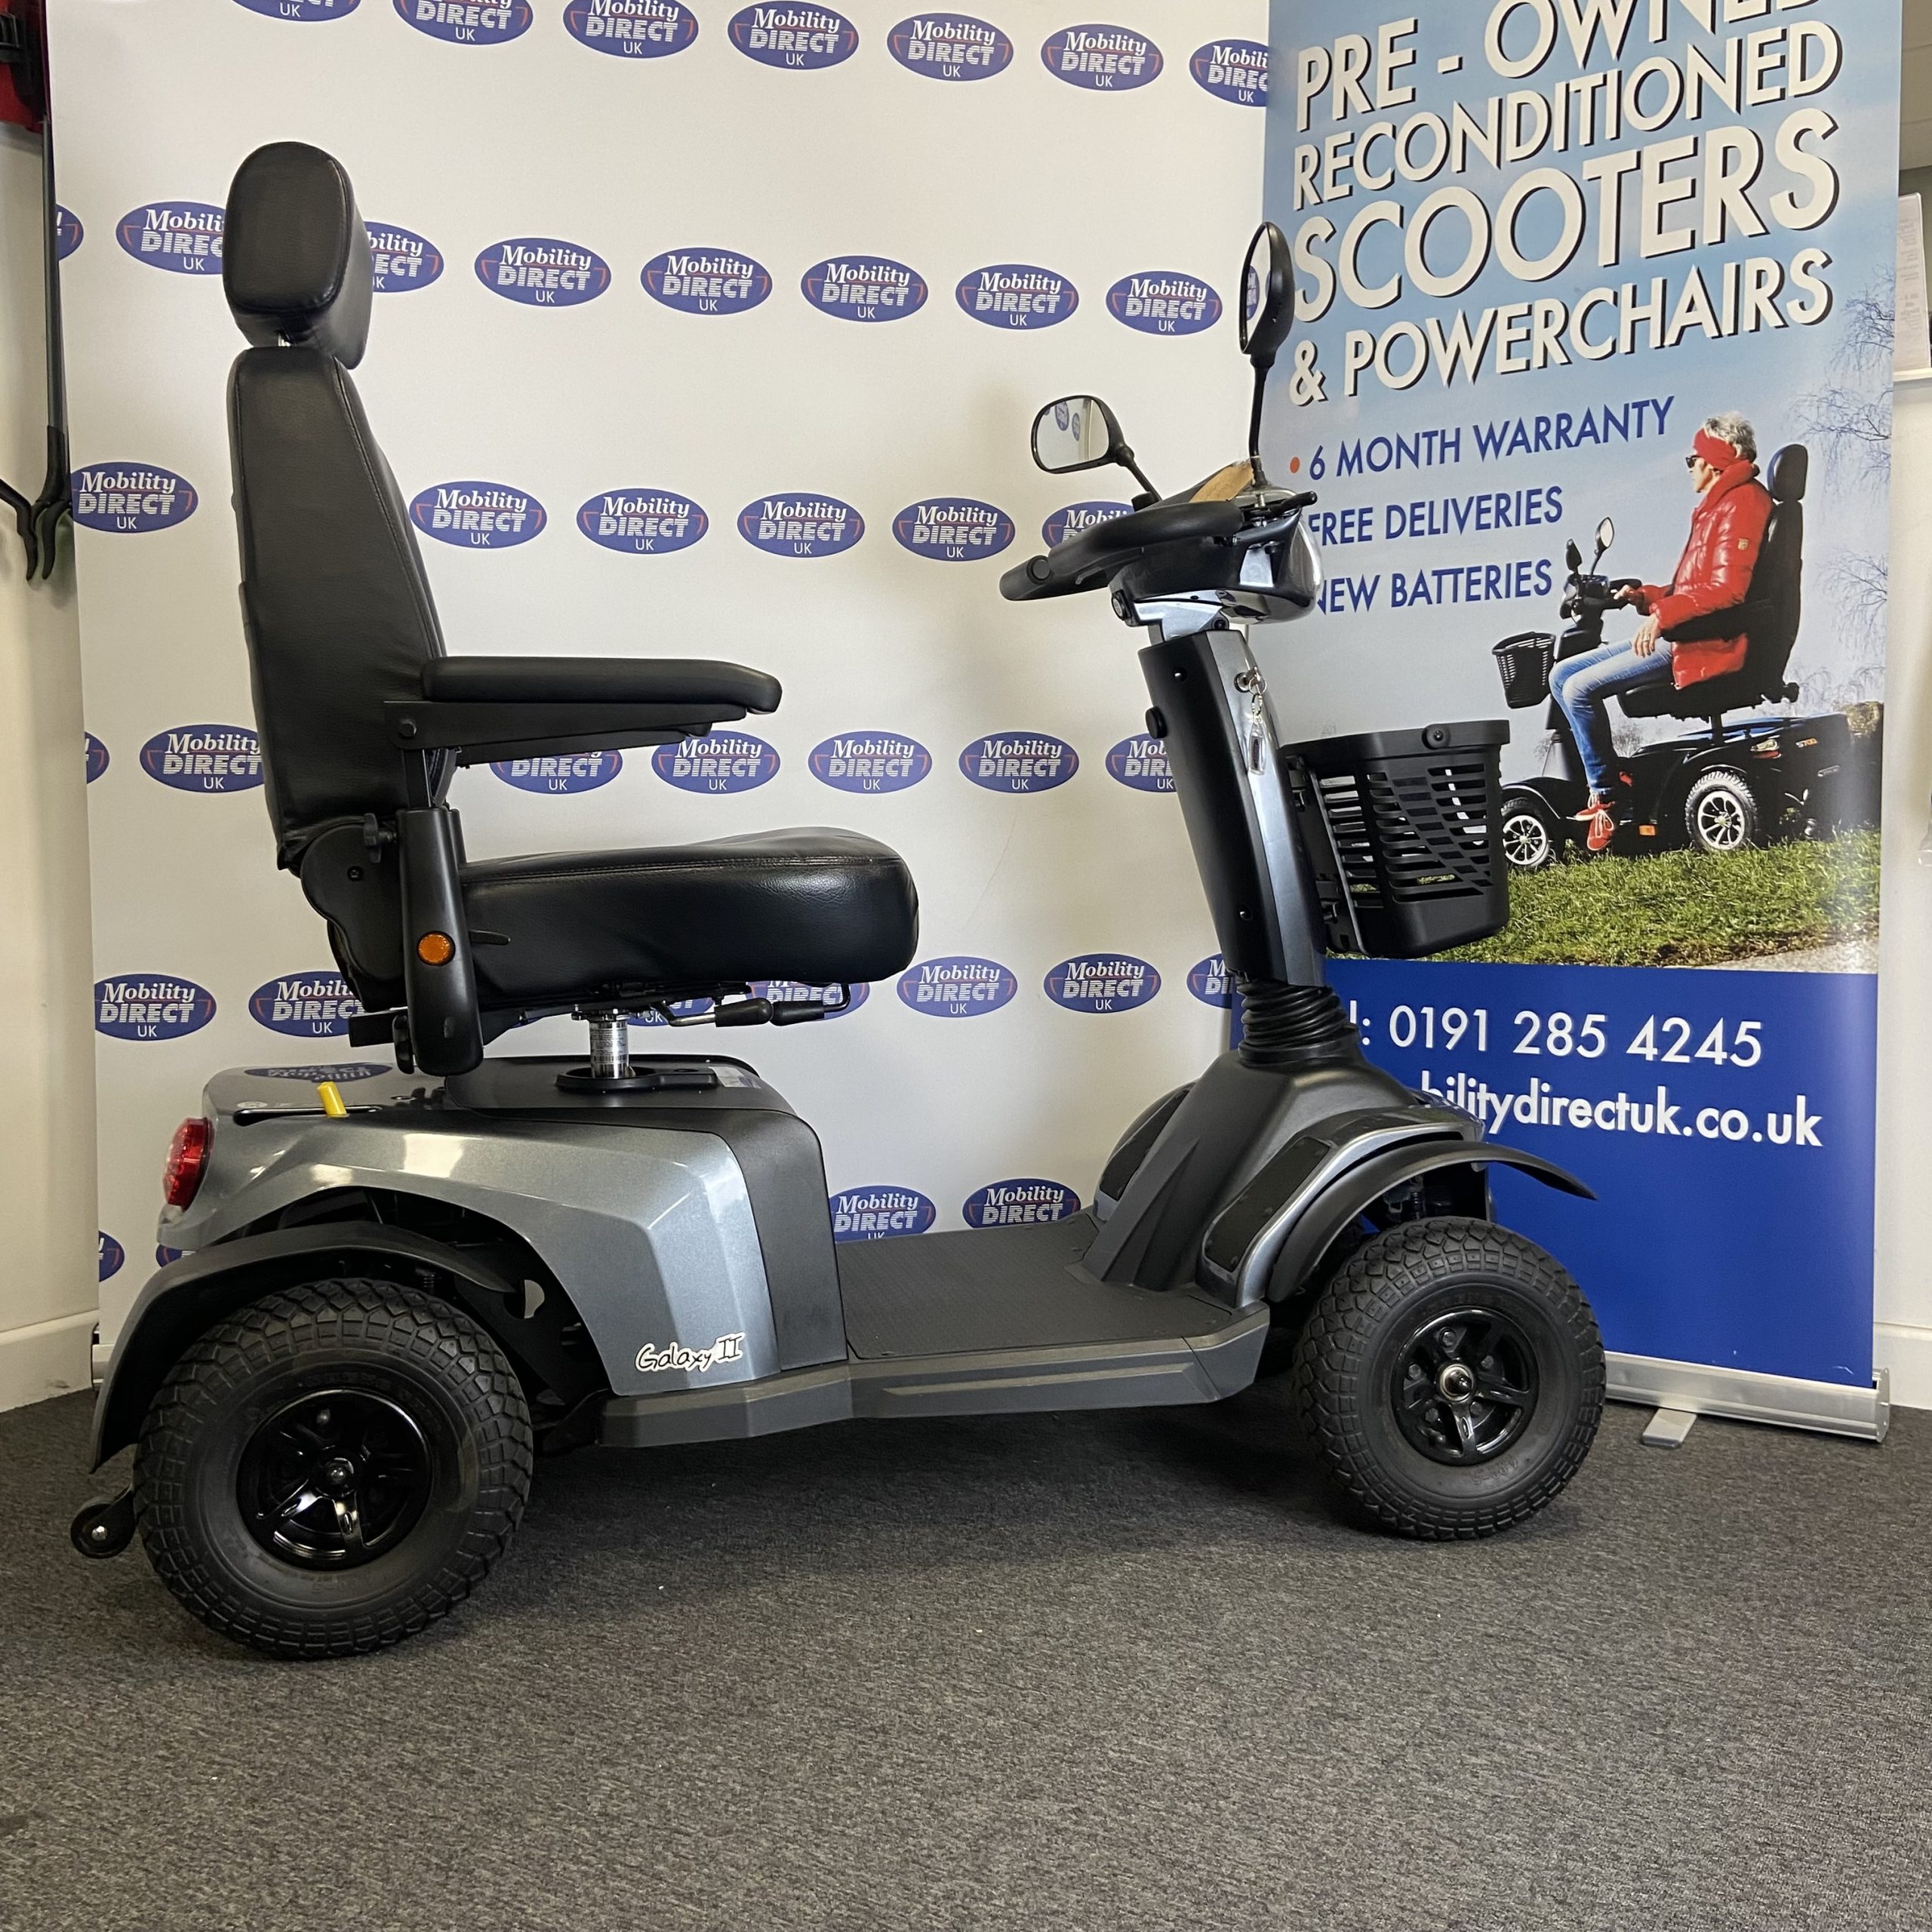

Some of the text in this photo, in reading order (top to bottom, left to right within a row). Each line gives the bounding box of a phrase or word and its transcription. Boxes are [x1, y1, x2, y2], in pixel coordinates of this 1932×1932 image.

[280, 2, 300, 17] UK
[416, 0, 512, 29] DIRECT
[587, 0, 679, 22] Mobility
[586, 17, 678, 42] DIRECT
[752, 8, 841, 34] Mobility
[455, 27, 475, 41] UK
[749, 29, 839, 53] DIRECT
[910, 20, 996, 46] Mobility
[1063, 31, 1147, 56] Mobility
[623, 42, 642, 54] UK
[908, 40, 995, 65] DIRECT
[1210, 45, 1268, 69] Mobili
[786, 53, 804, 66] UK
[1061, 51, 1146, 75] DIRECT
[943, 65, 961, 78] UK
[1096, 75, 1112, 88] UK
[1208, 65, 1268, 91] DIREC
[1297, 17, 1417, 132] PRE
[1238, 90, 1254, 103] UK
[1293, 20, 1843, 211] RECONDITIONED
[143, 209, 224, 232] Mobili
[1294, 108, 1840, 322] SCOOTERS
[140, 231, 223, 257] DIREC
[365, 231, 423, 257] bility
[183, 257, 205, 271] UK
[374, 254, 423, 278] ECT
[500, 245, 592, 271] Mobility
[664, 255, 754, 279] Mobility
[497, 266, 591, 290] DIRECT
[824, 263, 910, 287] Mobility
[977, 272, 1062, 294] Mobility
[536, 290, 555, 303] UK
[663, 275, 753, 298] DIRECT
[822, 283, 909, 306] DIRECT
[1128, 278, 1208, 302] Mobility
[700, 299, 718, 312] UK
[857, 306, 875, 318] UK
[975, 291, 1060, 313] DIRECT
[1125, 297, 1207, 320] DIRECT
[1010, 314, 1027, 326] UK
[1158, 320, 1174, 332] UK
[1289, 340, 1327, 406] &
[1343, 248, 1832, 396] POWERCHAIRS
[1309, 395, 1675, 481] 6 MONTH WARRANTY
[79, 472, 176, 494] Mobility
[78, 494, 175, 515] DIRECT
[434, 488, 528, 512] Mobility
[601, 496, 690, 518] Mobility
[432, 509, 527, 532] DIRECT
[760, 500, 847, 522] Mobility
[915, 506, 998, 527] Mobility
[1385, 485, 1563, 540] DELIVERIES
[116, 517, 137, 530] UK
[598, 516, 689, 537] DIRECT
[758, 521, 846, 541] DIRECT
[471, 532, 491, 545] UK
[635, 539, 654, 551] UK
[912, 525, 997, 545] DIRECT
[794, 543, 812, 554] UK
[947, 546, 964, 558] UK
[1391, 558, 1552, 609] BATTERIES
[165, 734, 261, 754] Mobility
[675, 739, 762, 758] Mobility
[830, 739, 915, 758] Mobility
[980, 740, 1063, 758] Mobility
[163, 755, 262, 774] DIRECT
[511, 758, 602, 777] DIRECT
[672, 758, 761, 777] DIRECT
[829, 758, 914, 777] DIRECT
[979, 759, 1061, 777] DIRECT
[204, 777, 225, 789] UK
[549, 779, 568, 791] UK
[709, 779, 727, 791] UK
[863, 779, 881, 790] UK
[1012, 779, 1029, 790] UK
[1157, 778, 1174, 789] UK
[919, 964, 1001, 985] Mobility
[1065, 961, 1145, 981] Mobility
[101, 983, 195, 1003] Mobility
[274, 980, 353, 1001] Mobili
[917, 982, 999, 1003] DIRECT
[1063, 979, 1144, 998] DIRECT
[100, 1004, 195, 1023] DIRECT
[950, 1003, 967, 1014] UK
[1096, 999, 1112, 1011] UK
[137, 1025, 157, 1037] UK
[312, 1022, 333, 1033] UK
[1389, 1005, 1487, 1051] 0191
[1513, 1011, 1607, 1058] 285
[1626, 1014, 1762, 1068] 4245
[835, 1193, 918, 1214] Mobility
[984, 1186, 1064, 1206] Mobility
[833, 1211, 918, 1232] DIRECT
[982, 1203, 1063, 1225] DIRECT
[637, 1334, 744, 1371] Galaxy II
